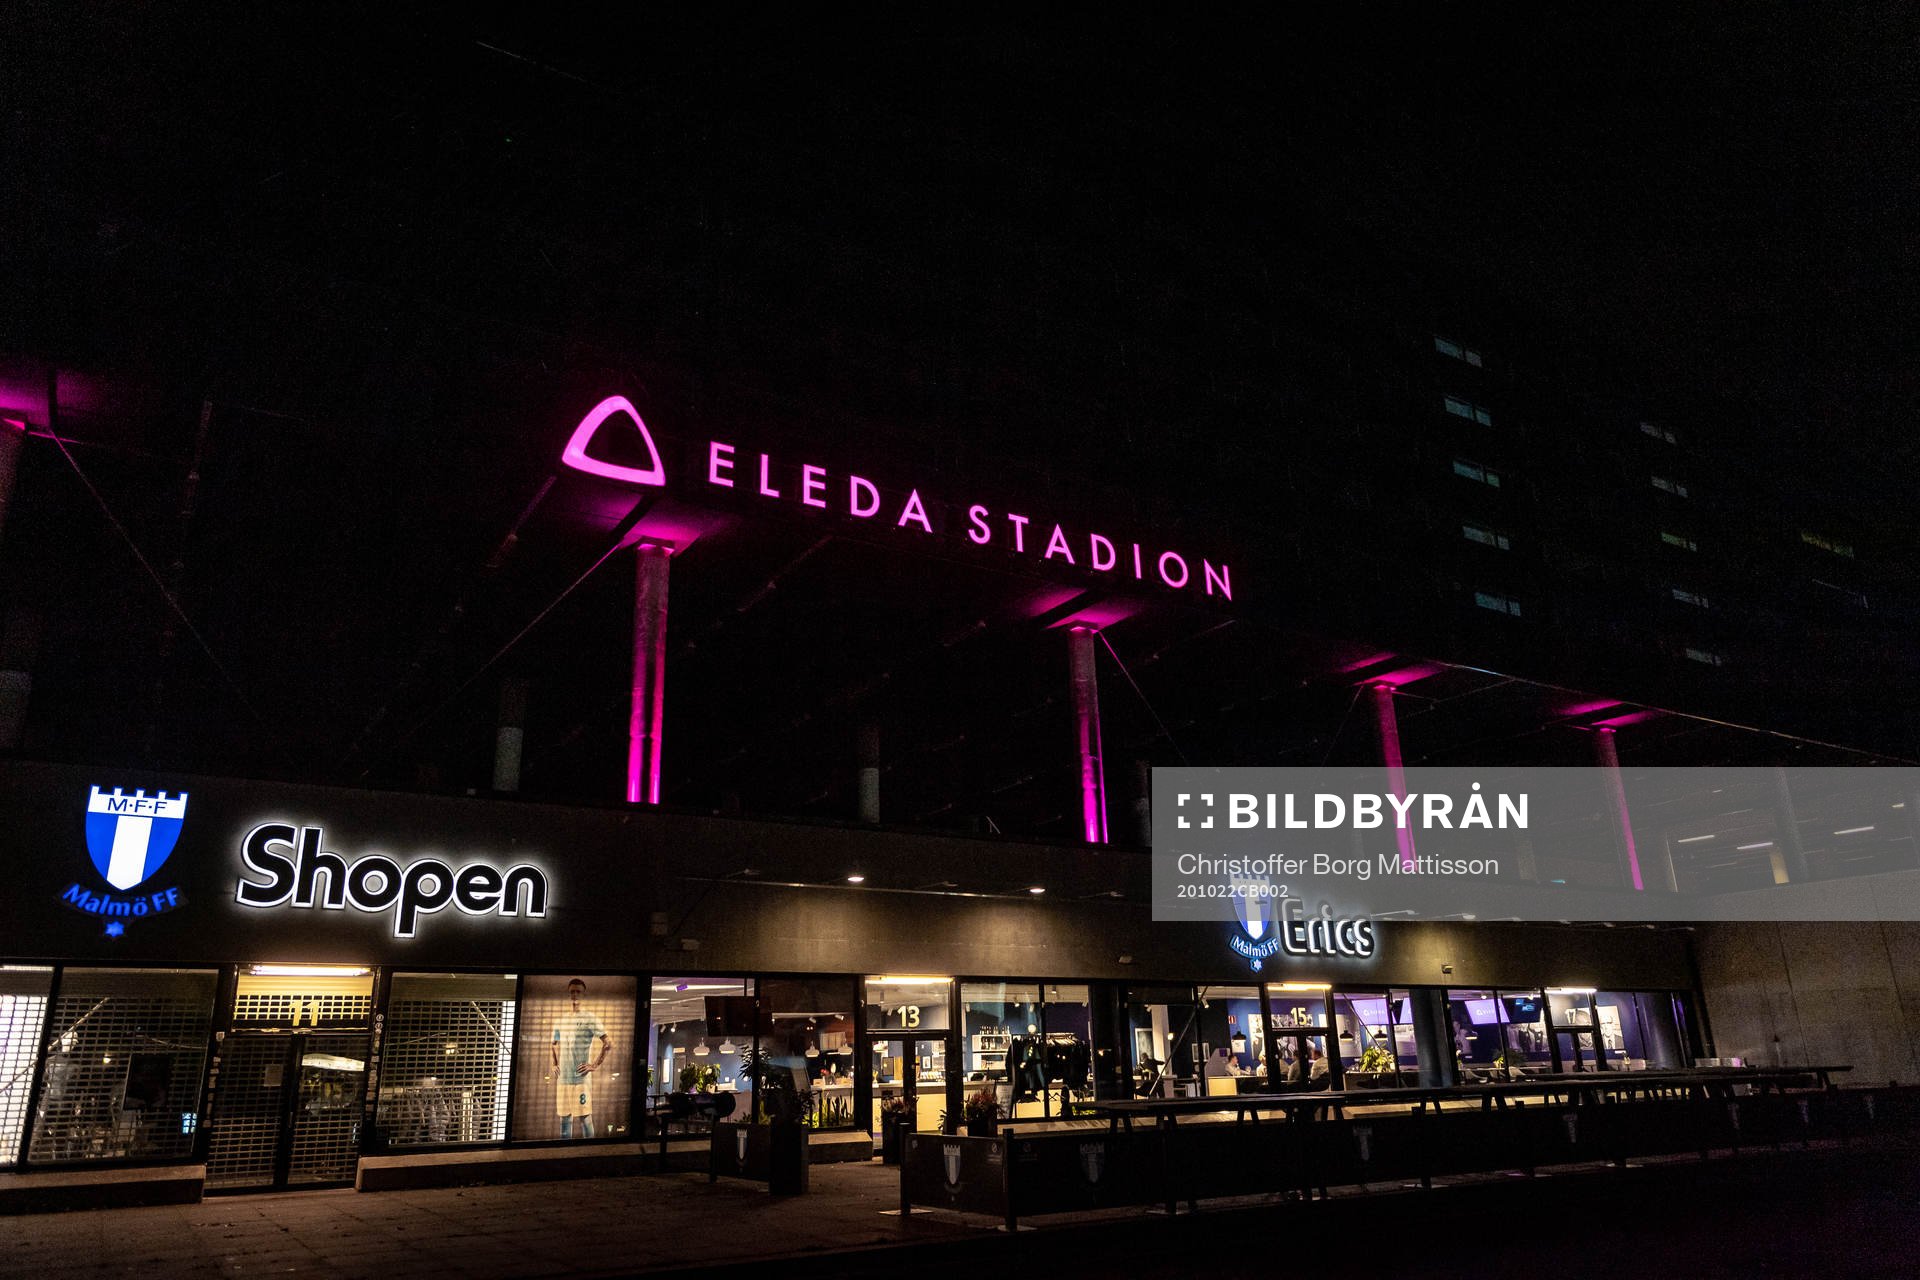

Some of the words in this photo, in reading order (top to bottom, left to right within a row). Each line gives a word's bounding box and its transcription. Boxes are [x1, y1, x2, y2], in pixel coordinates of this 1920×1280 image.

[709, 441, 933, 534] ELEDA
[968, 504, 1232, 601] STADION
[236, 822, 548, 938] Shopen
[62, 883, 149, 917] Malmö
[151, 887, 179, 912] FF
[1277, 895, 1375, 959] Erics
[1233, 936, 1267, 957] Malmö
[1267, 937, 1279, 955] FF
[289, 1001, 320, 1027] 11
[897, 1005, 920, 1028] 13
[1290, 1007, 1307, 1026] 15
[579, 1093, 587, 1105] 8
